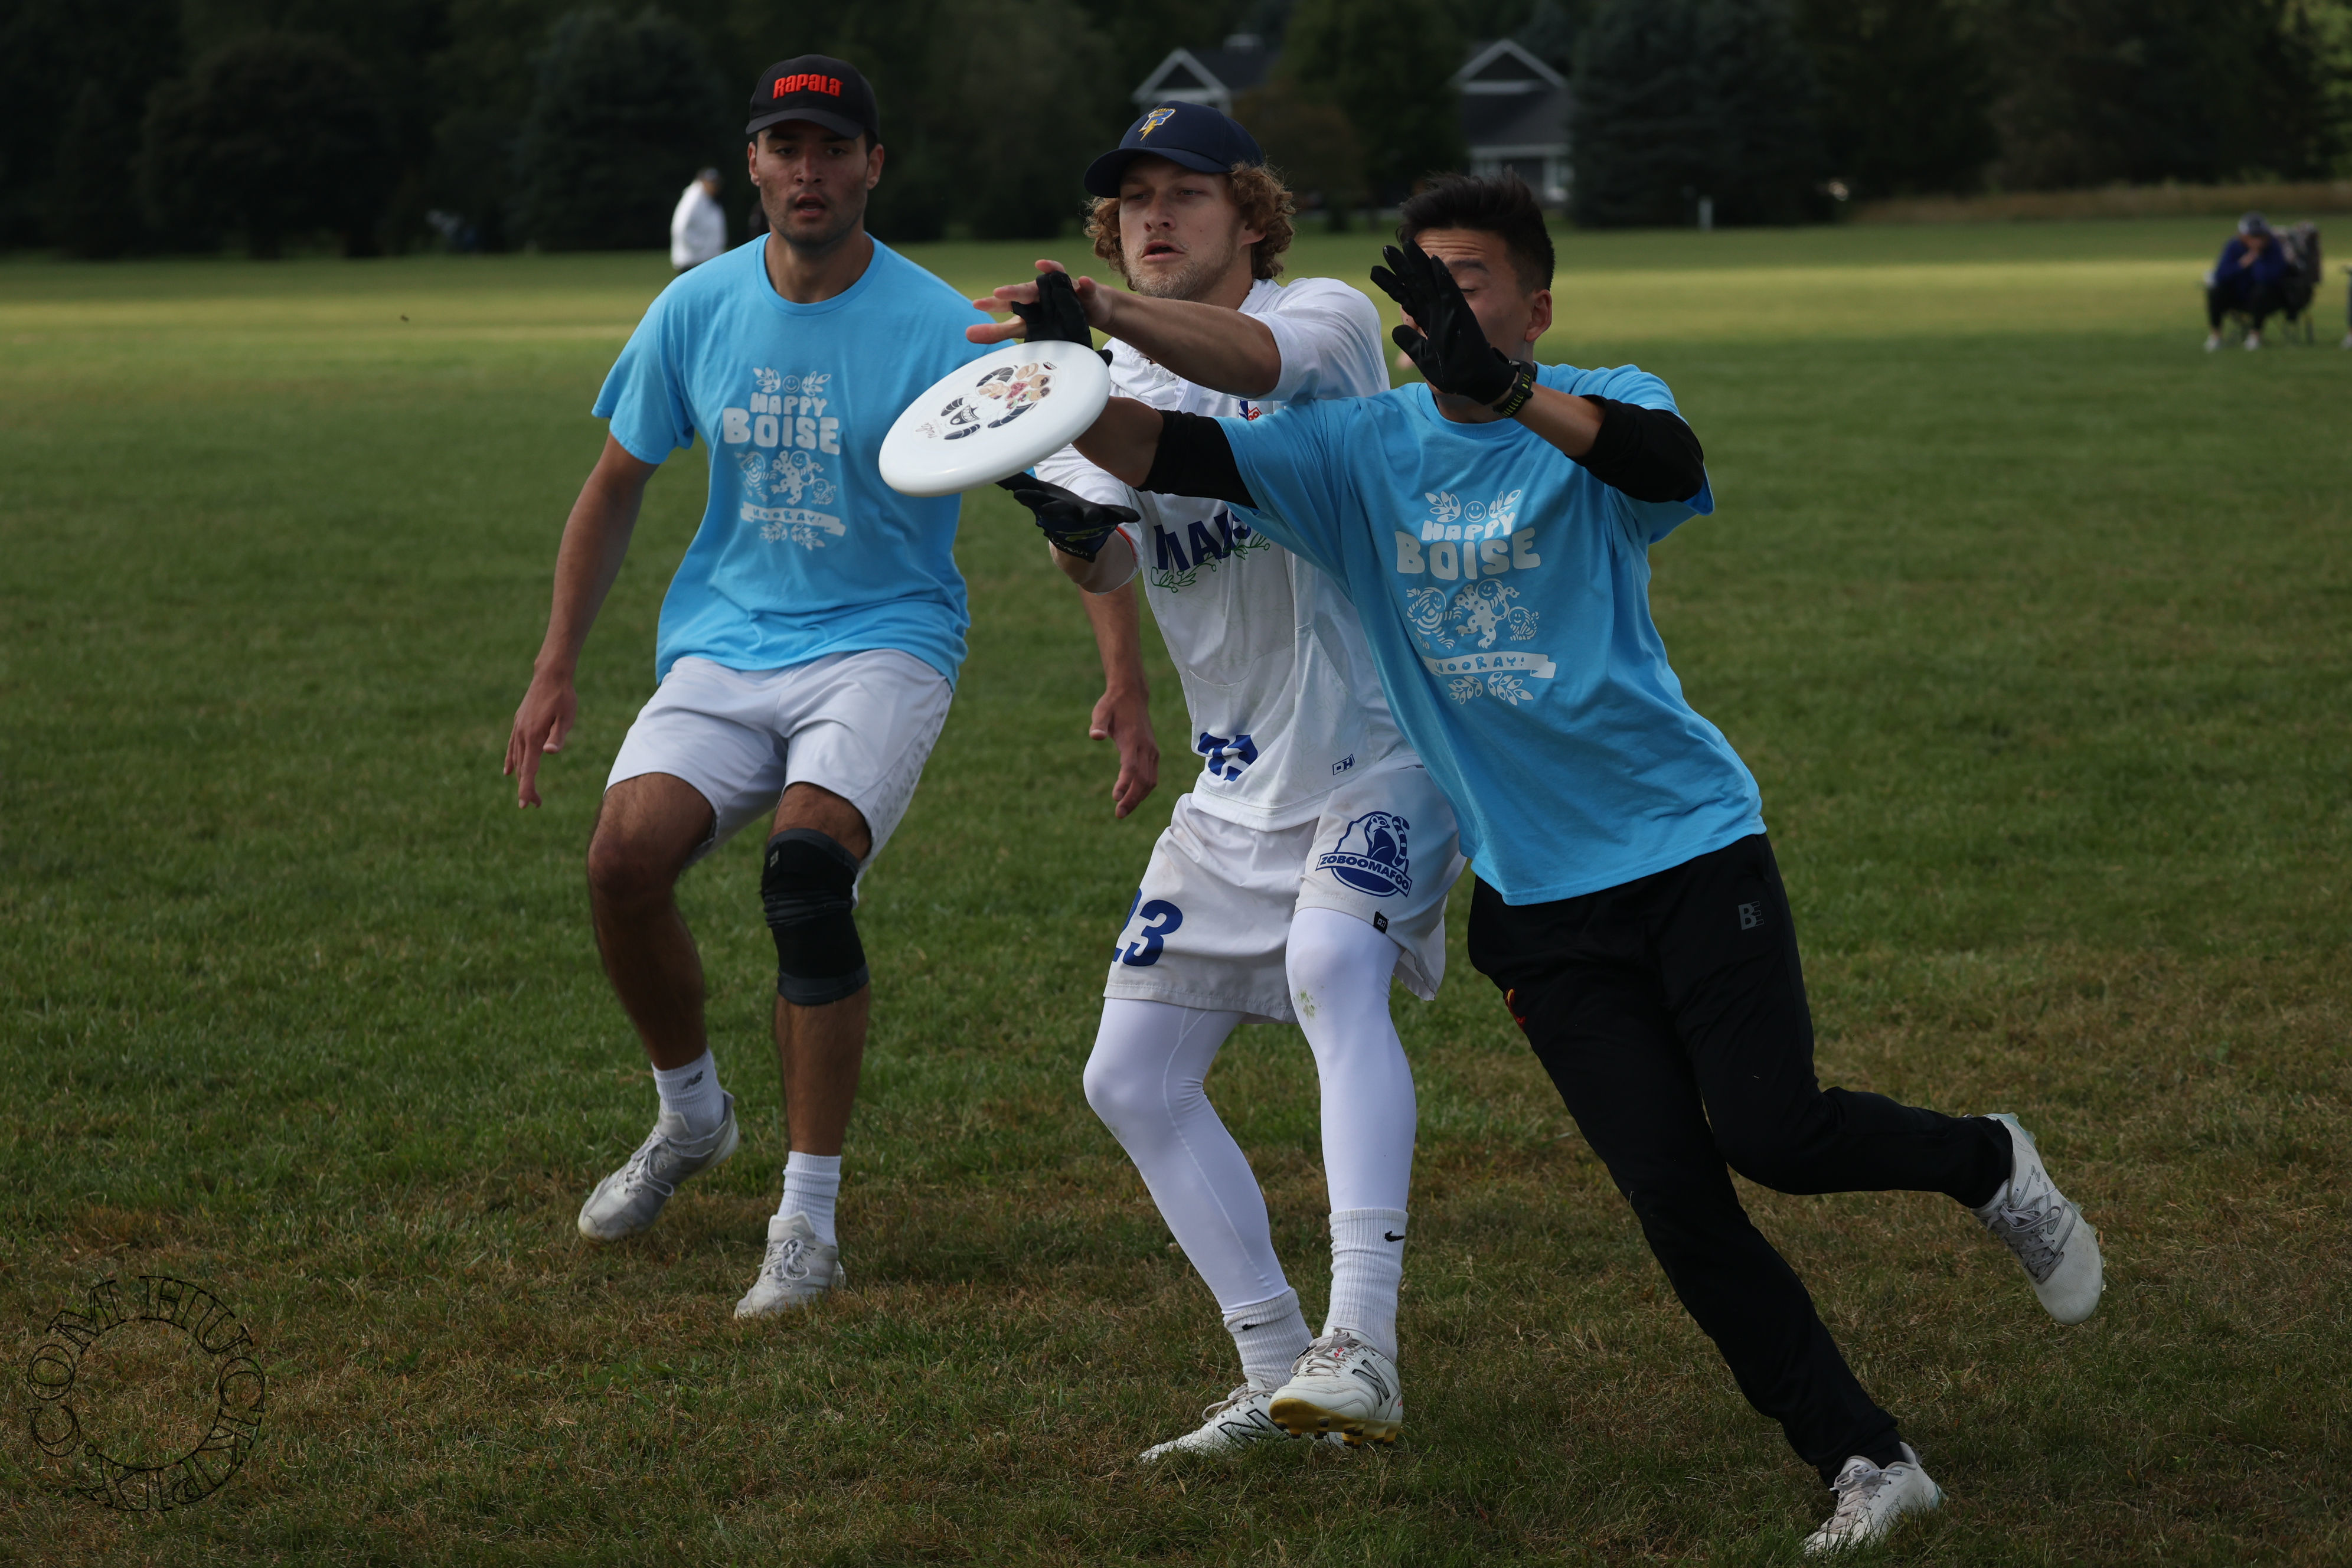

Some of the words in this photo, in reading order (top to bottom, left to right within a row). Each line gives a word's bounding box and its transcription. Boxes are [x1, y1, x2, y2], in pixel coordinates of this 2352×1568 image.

[750, 392, 827, 417] HAPPY
[722, 407, 840, 455] BOISE
[753, 508, 822, 524] HOORAY!
[1421, 512, 1515, 541] HAPPY
[1395, 527, 1541, 580] BOISE
[1435, 656, 1525, 672] HOORAY!
[1319, 855, 1409, 890] ZOBOOMAFOO
[1112, 888, 1183, 967] 3
